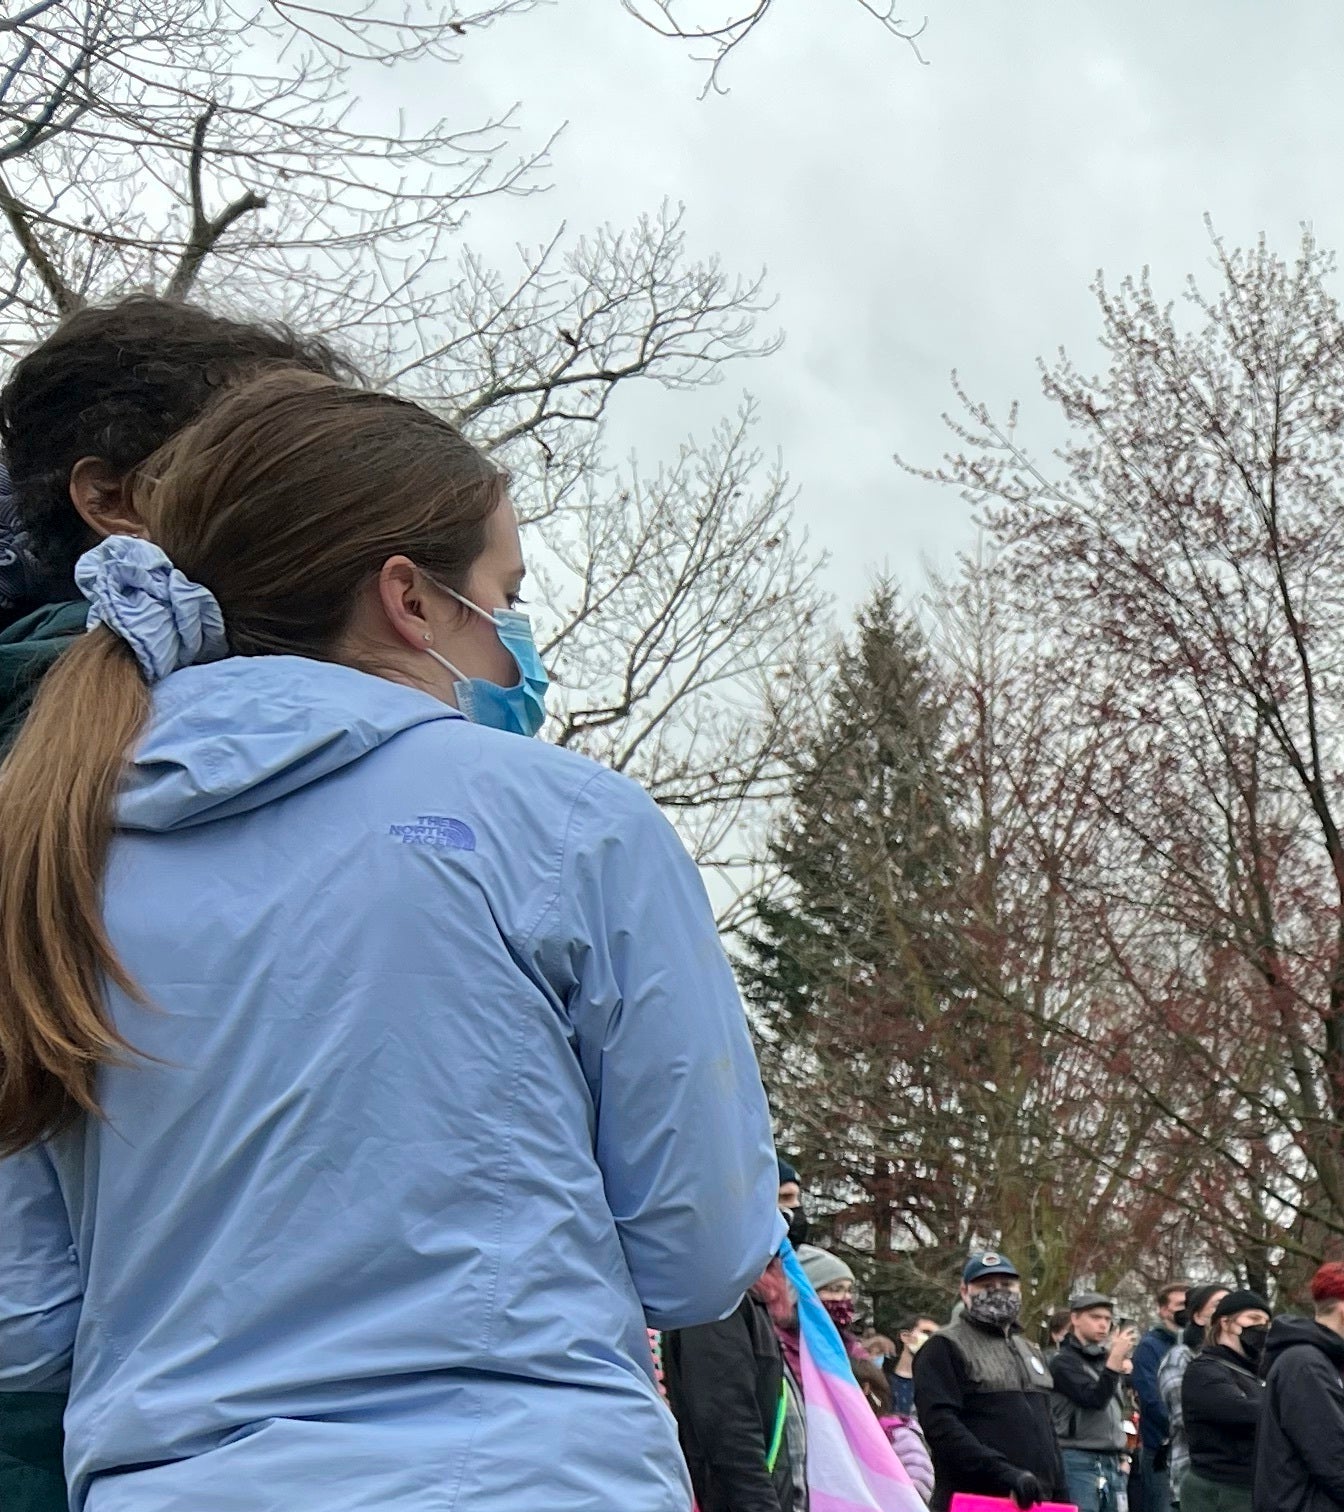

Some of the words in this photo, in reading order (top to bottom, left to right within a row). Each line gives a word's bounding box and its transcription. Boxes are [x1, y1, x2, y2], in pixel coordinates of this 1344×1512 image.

[416, 815, 450, 827] THE
[389, 824, 447, 837] NORTH
[402, 835, 448, 847] FACE
